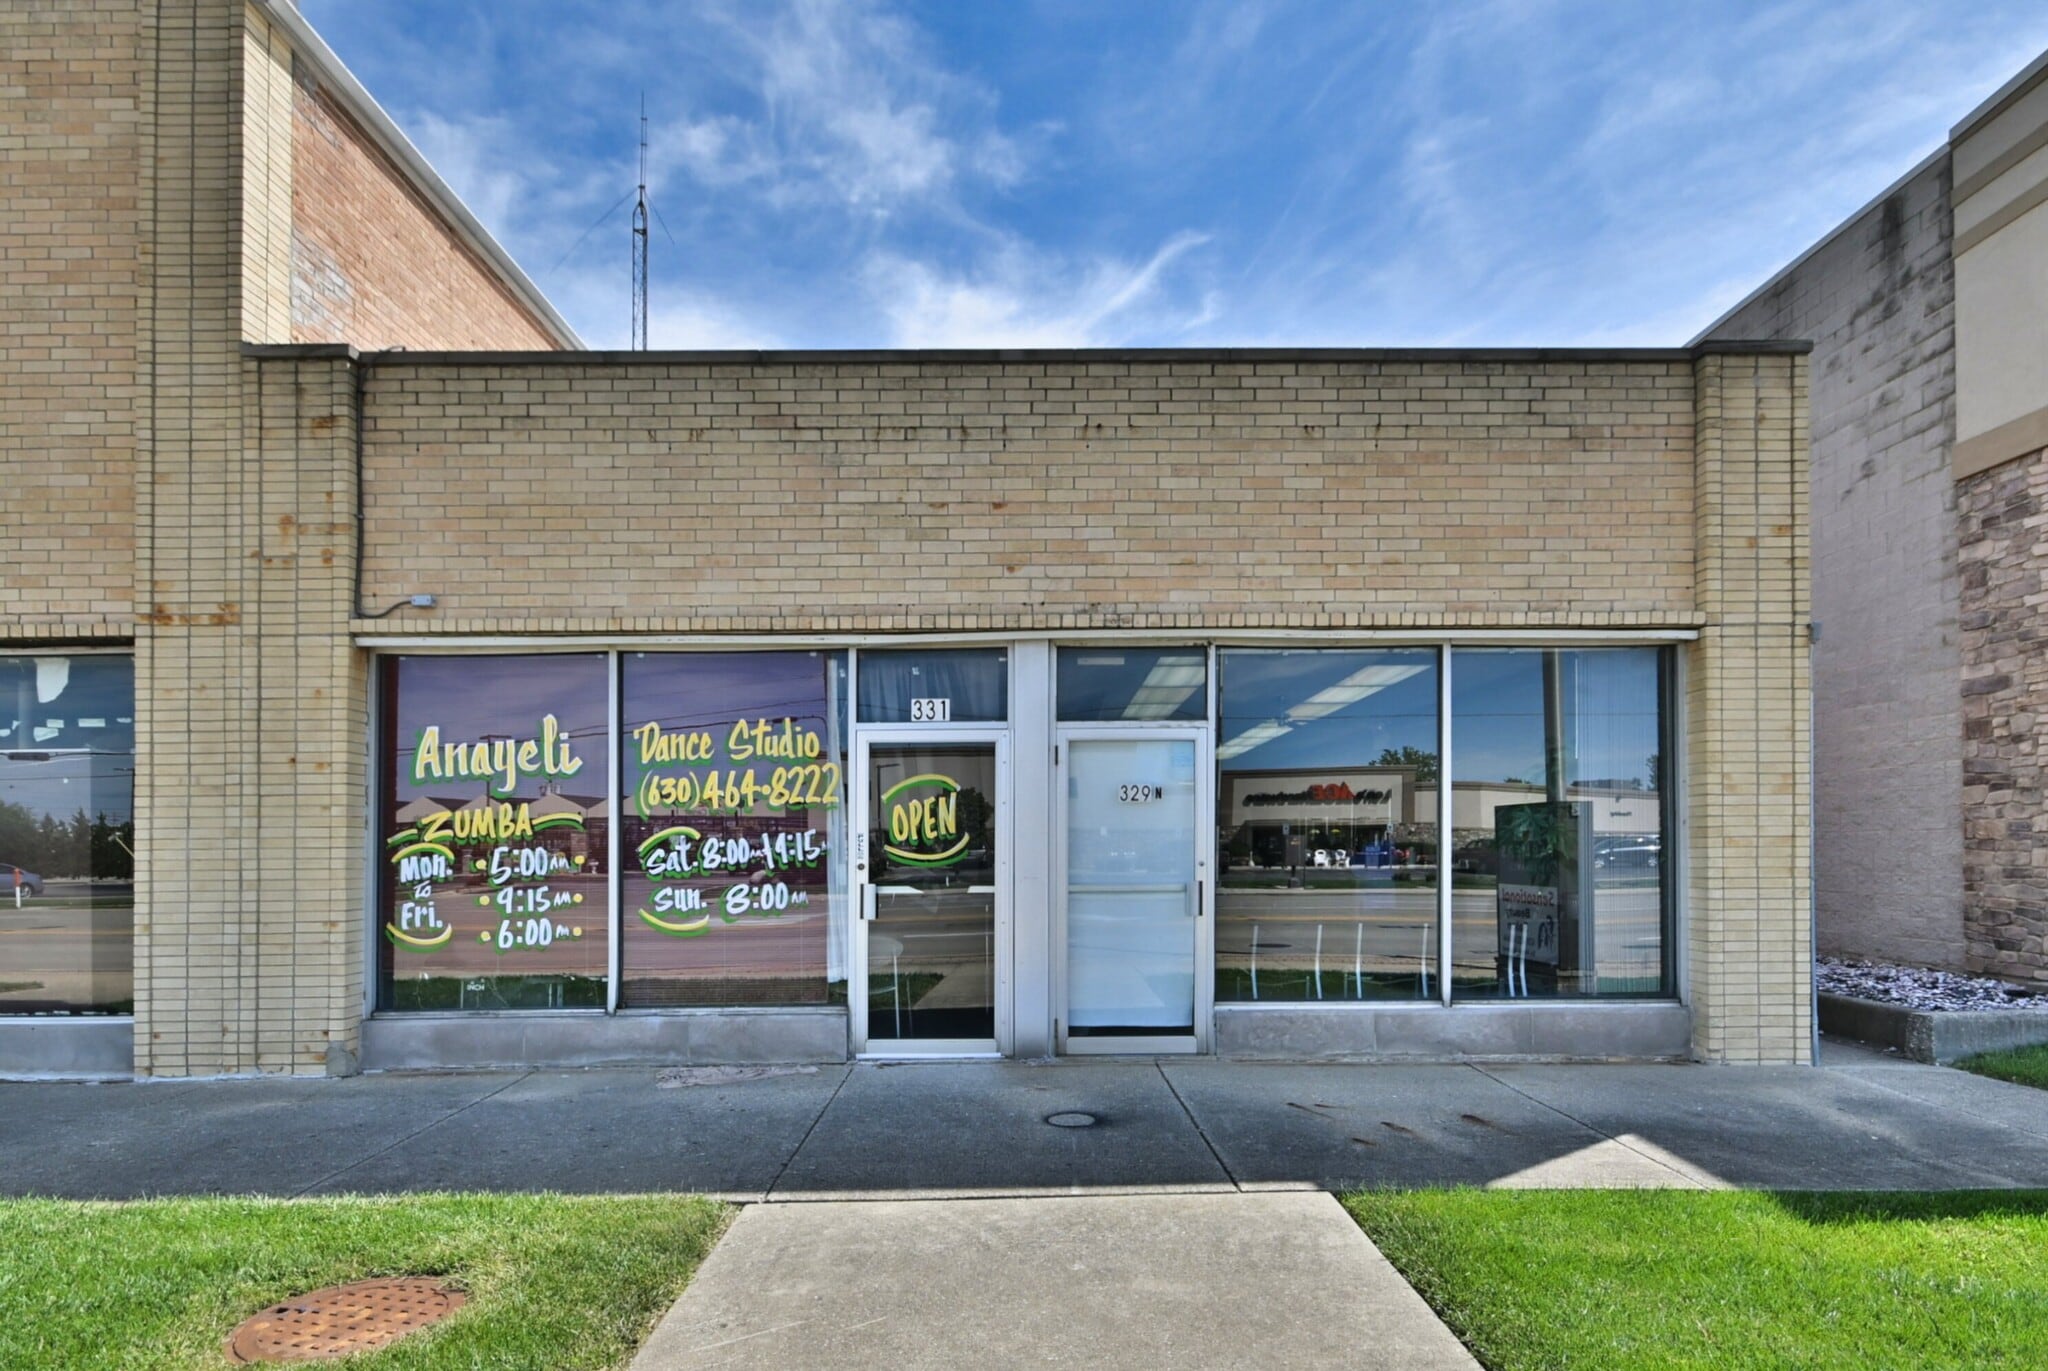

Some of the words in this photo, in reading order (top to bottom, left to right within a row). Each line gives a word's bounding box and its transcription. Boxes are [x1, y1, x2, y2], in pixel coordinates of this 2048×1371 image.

[912, 700, 948, 720] 331
[415, 713, 583, 792] Anayeli
[633, 721, 714, 764] Dance
[729, 717, 820, 760] Studio
[1119, 785, 1151, 802] 329
[422, 803, 533, 842] ZUMBA
[892, 791, 957, 842] OPEN
[647, 834, 699, 875] Sat.
[401, 901, 443, 930] Fri.
[654, 886, 708, 912] Sun.
